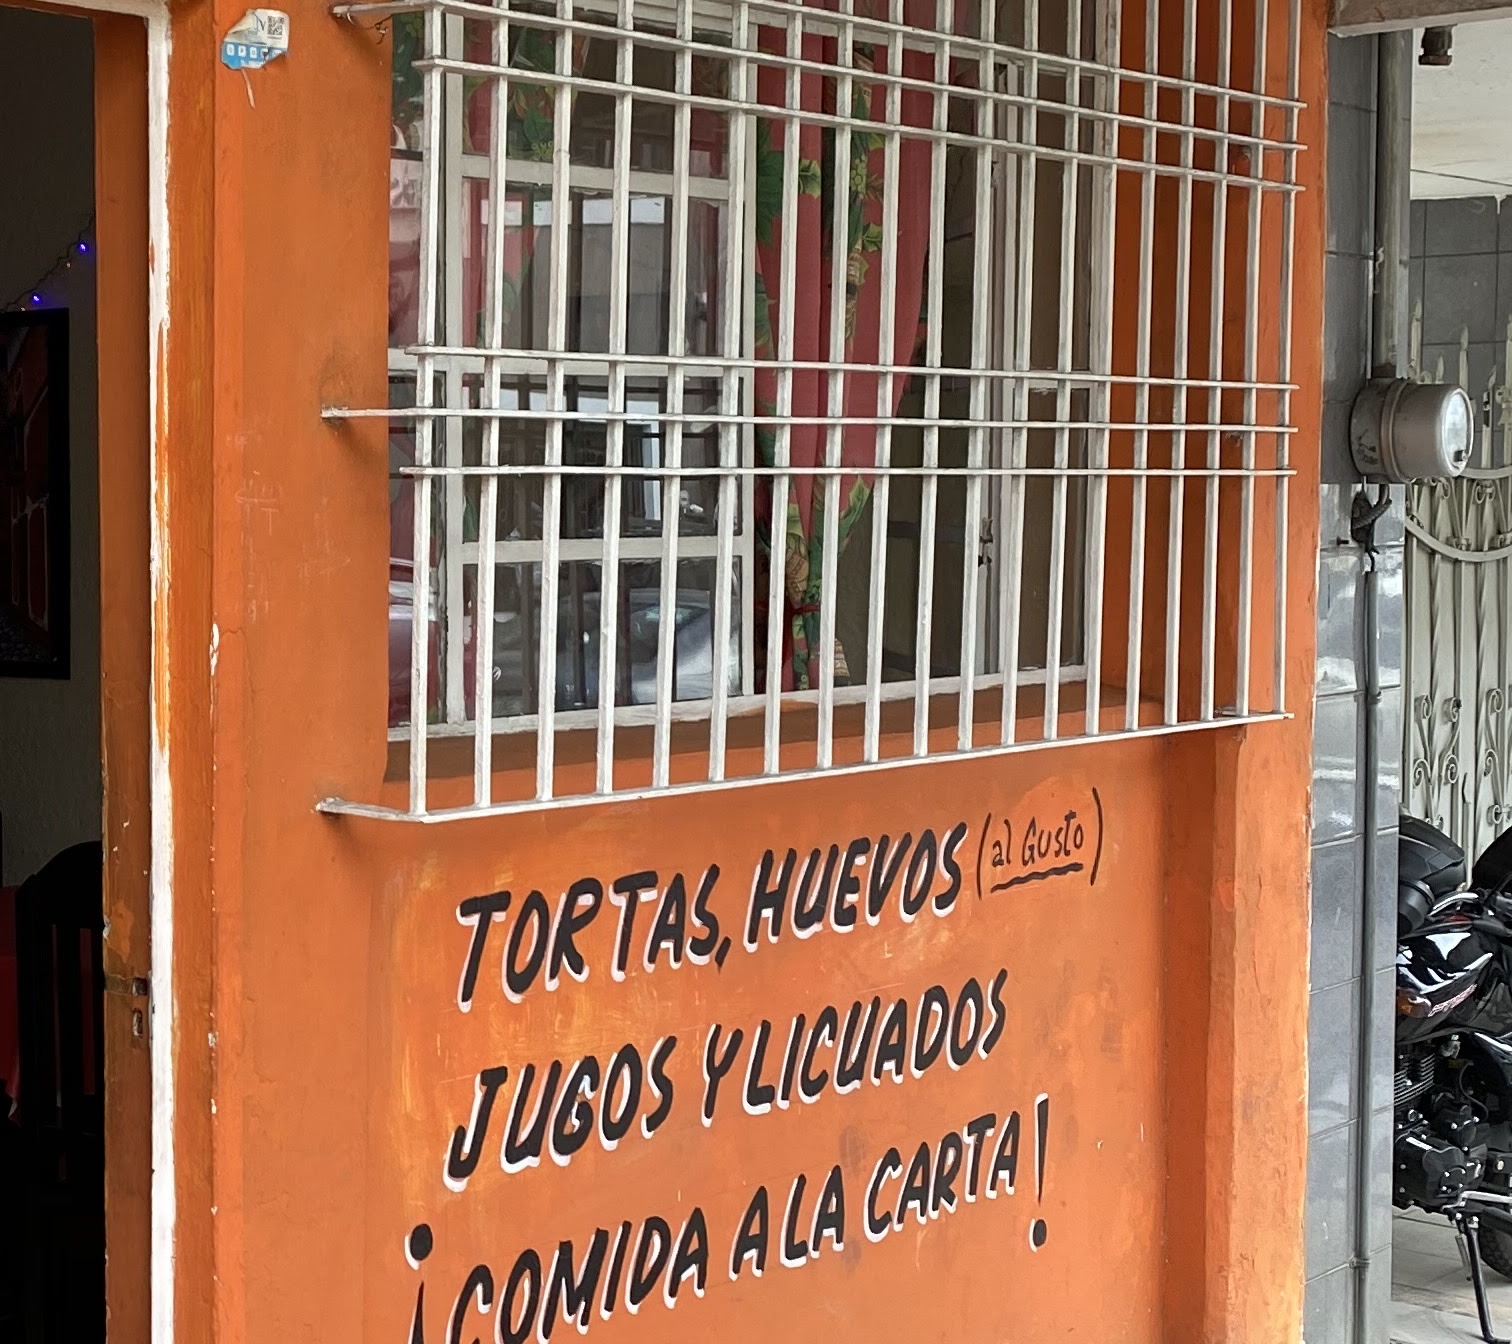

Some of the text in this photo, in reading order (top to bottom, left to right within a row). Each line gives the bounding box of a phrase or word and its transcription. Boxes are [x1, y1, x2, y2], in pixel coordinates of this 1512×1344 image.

[456, 862, 732, 1012] TORTAS,
[742, 821, 969, 953] HUEVOS
[443, 968, 1009, 1192] JUGOS Y LICUADOS
[729, 1185, 771, 1282] A
[777, 1164, 845, 1269] LA
[864, 1092, 1051, 1253] CARTA!
